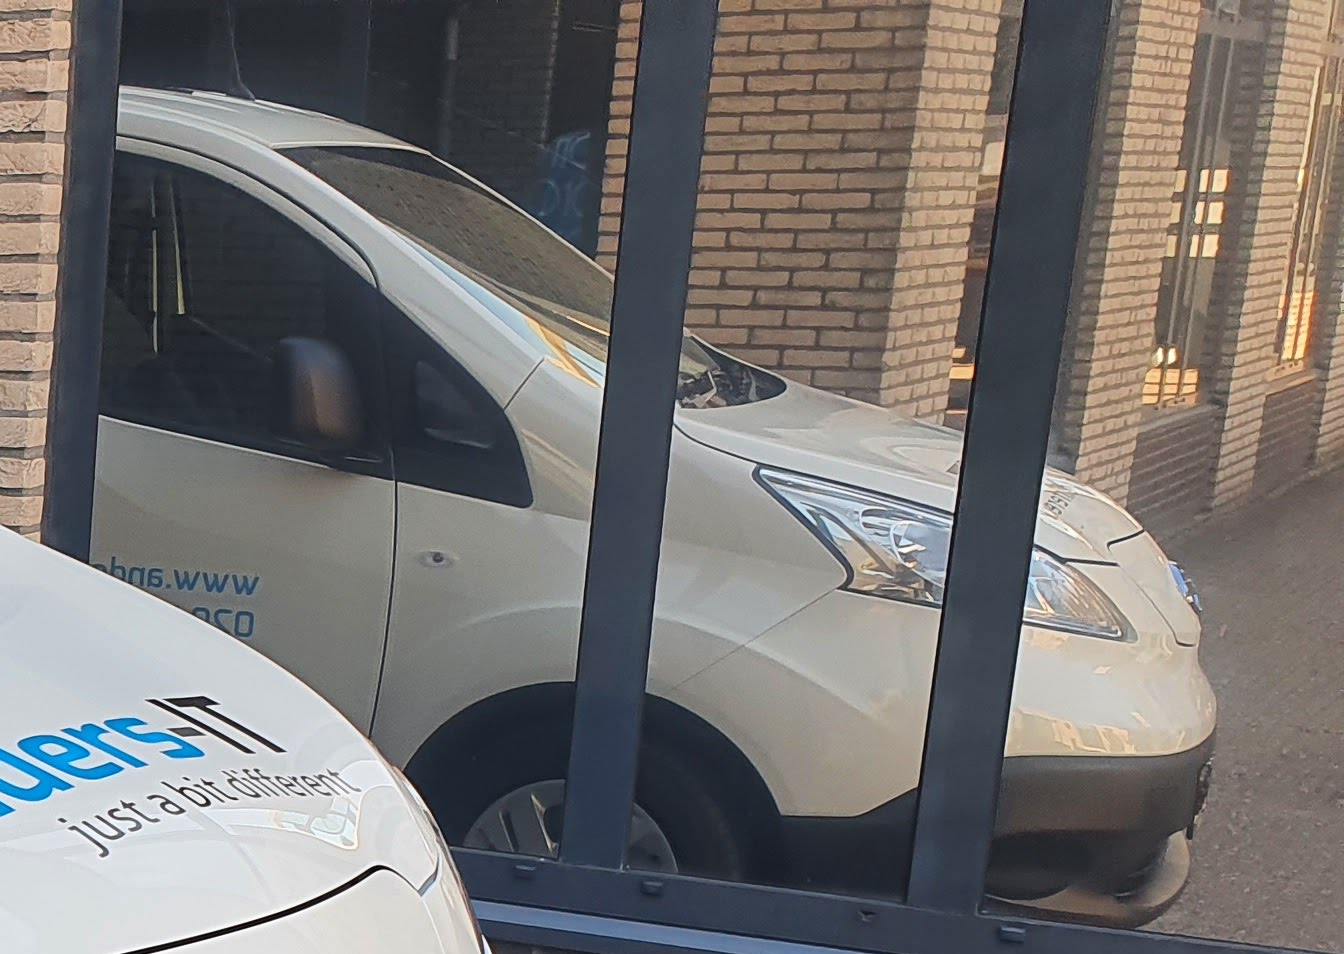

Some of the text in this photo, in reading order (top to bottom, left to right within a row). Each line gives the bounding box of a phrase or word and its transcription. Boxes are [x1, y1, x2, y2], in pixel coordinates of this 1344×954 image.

[57, 767, 362, 859] just a bit different
